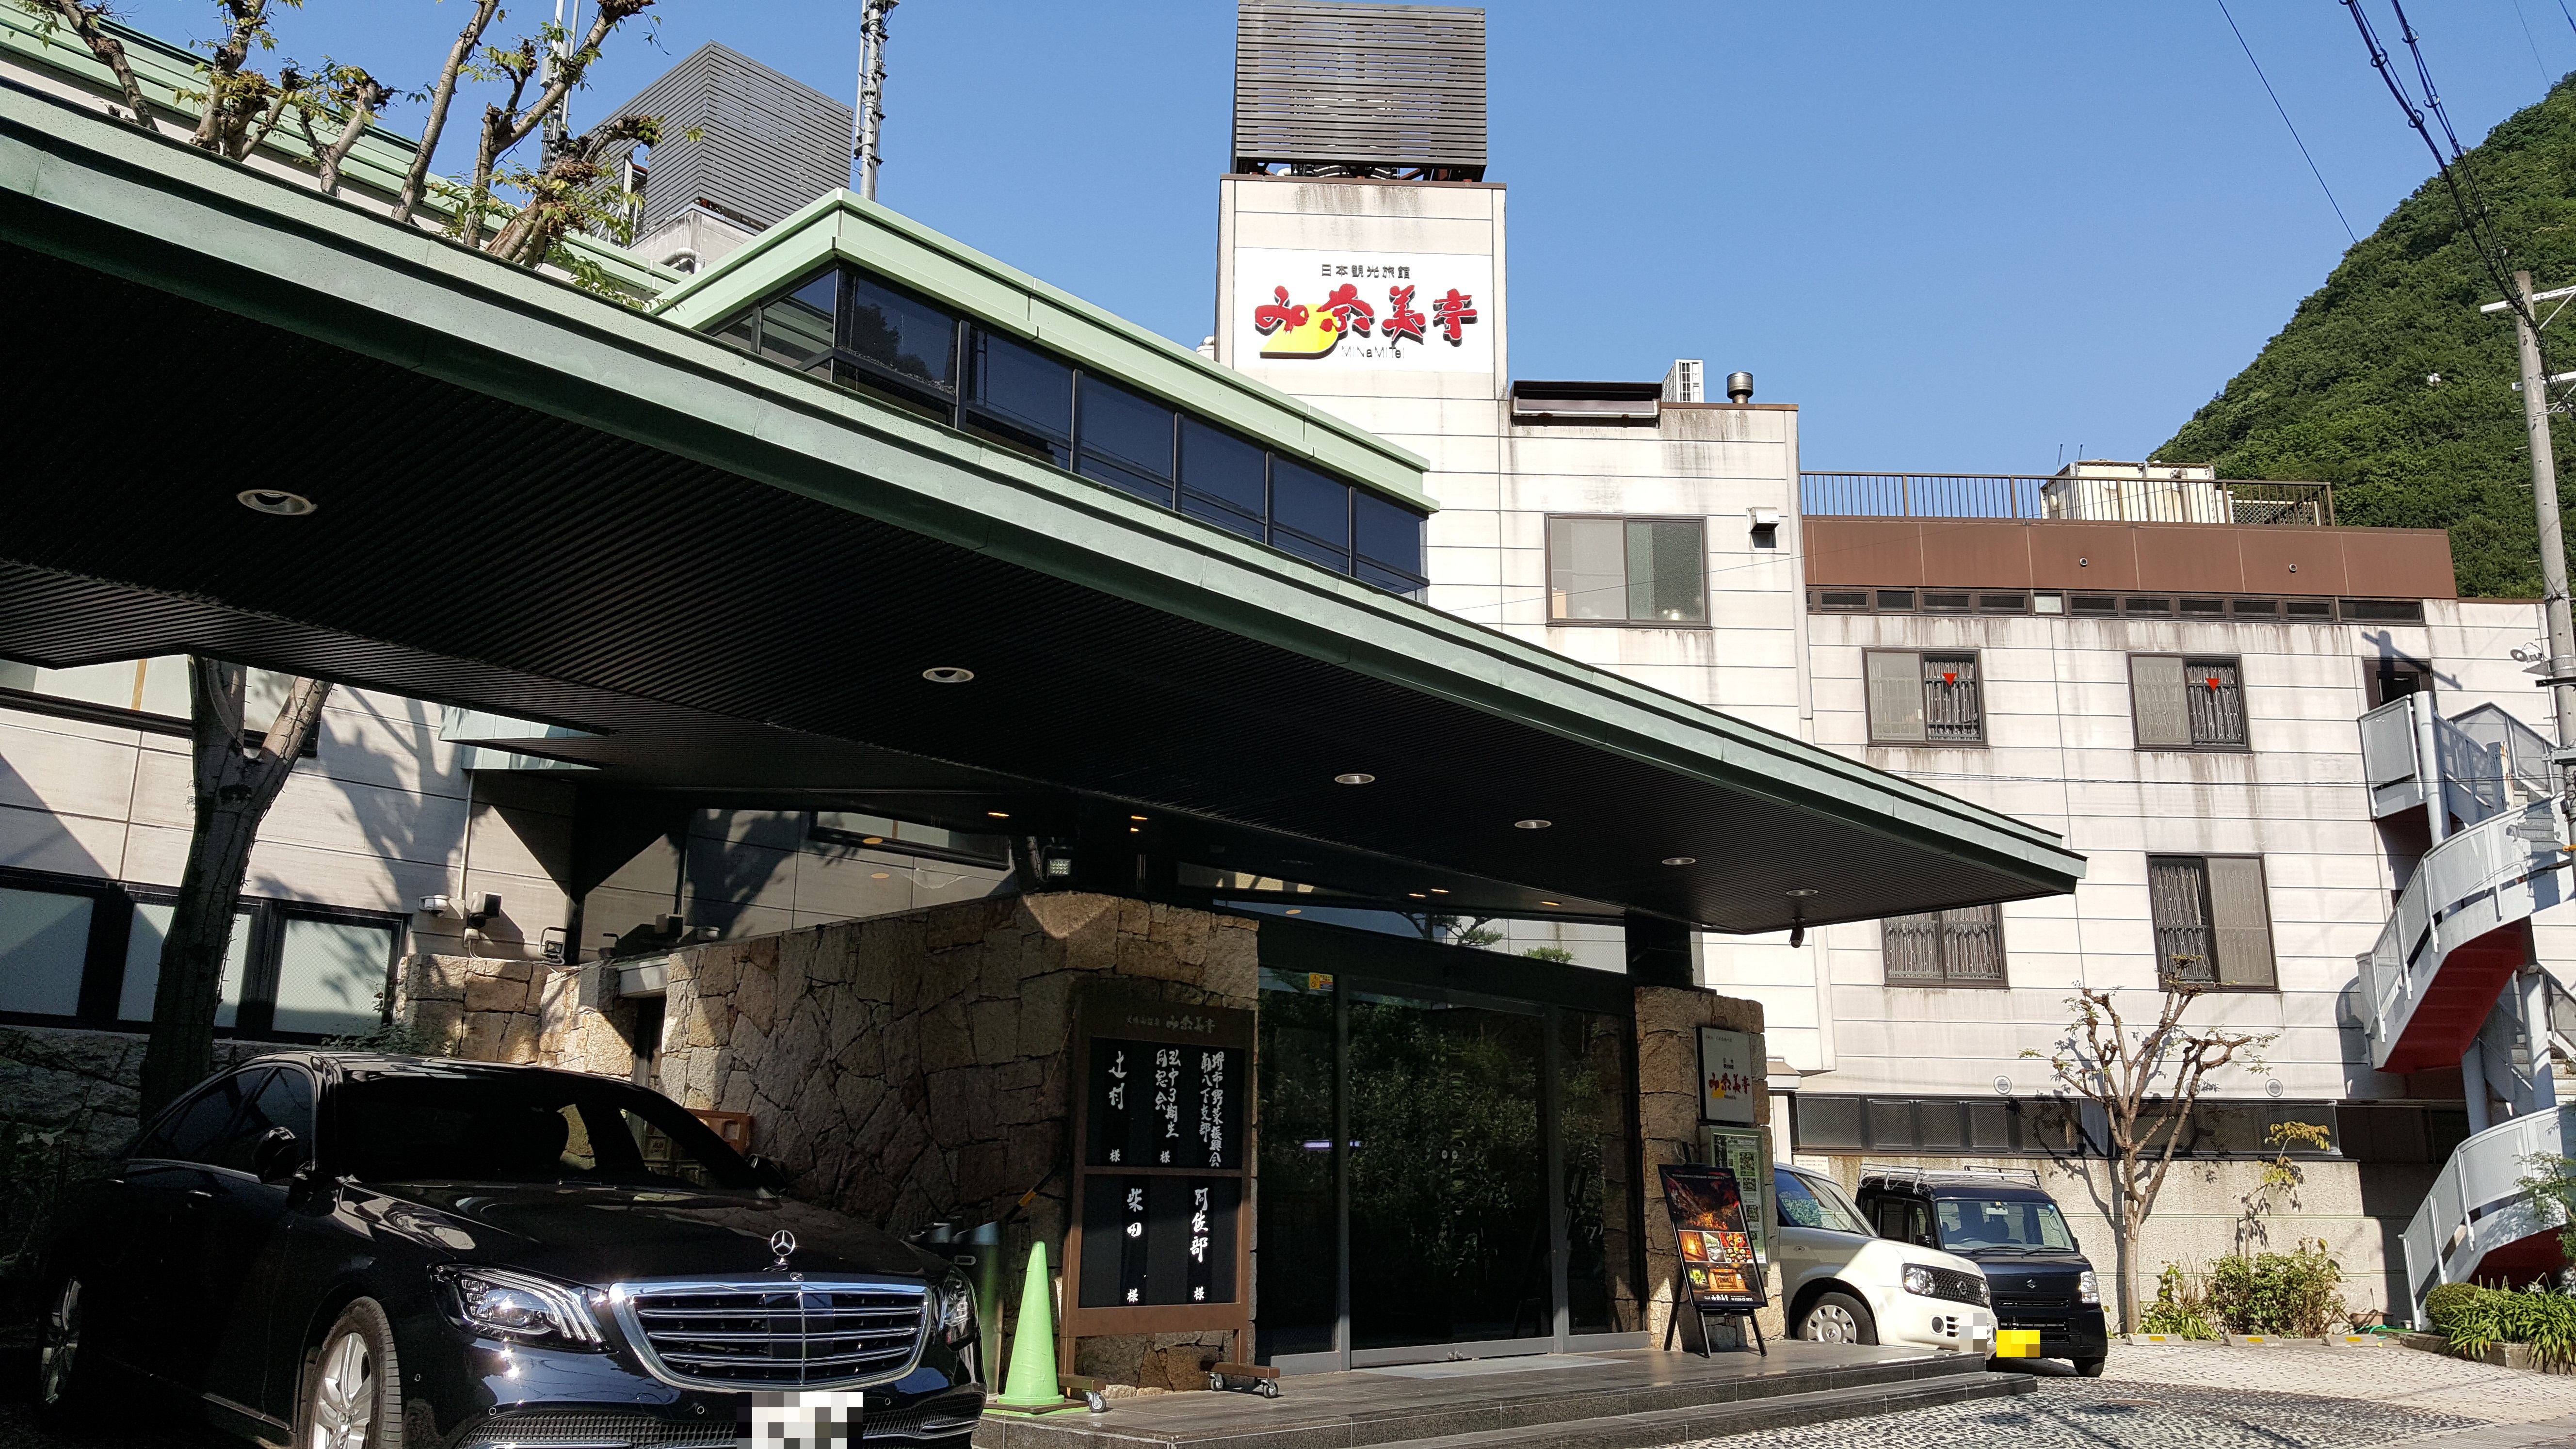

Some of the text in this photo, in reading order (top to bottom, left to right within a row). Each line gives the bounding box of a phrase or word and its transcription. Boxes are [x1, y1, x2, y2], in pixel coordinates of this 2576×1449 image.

[1321, 264, 1410, 279] 日本観光旅館
[1108, 1050, 1127, 1162] 辻村 様
[1155, 1049, 1171, 1163] 同窓会 様
[1165, 1049, 1181, 1138] 弘中3期生
[1199, 1052, 1212, 1143] 南八下支部
[1127, 1188, 1143, 1303] 柴田 様
[1190, 1187, 1208, 1301] 阿佐部 様
